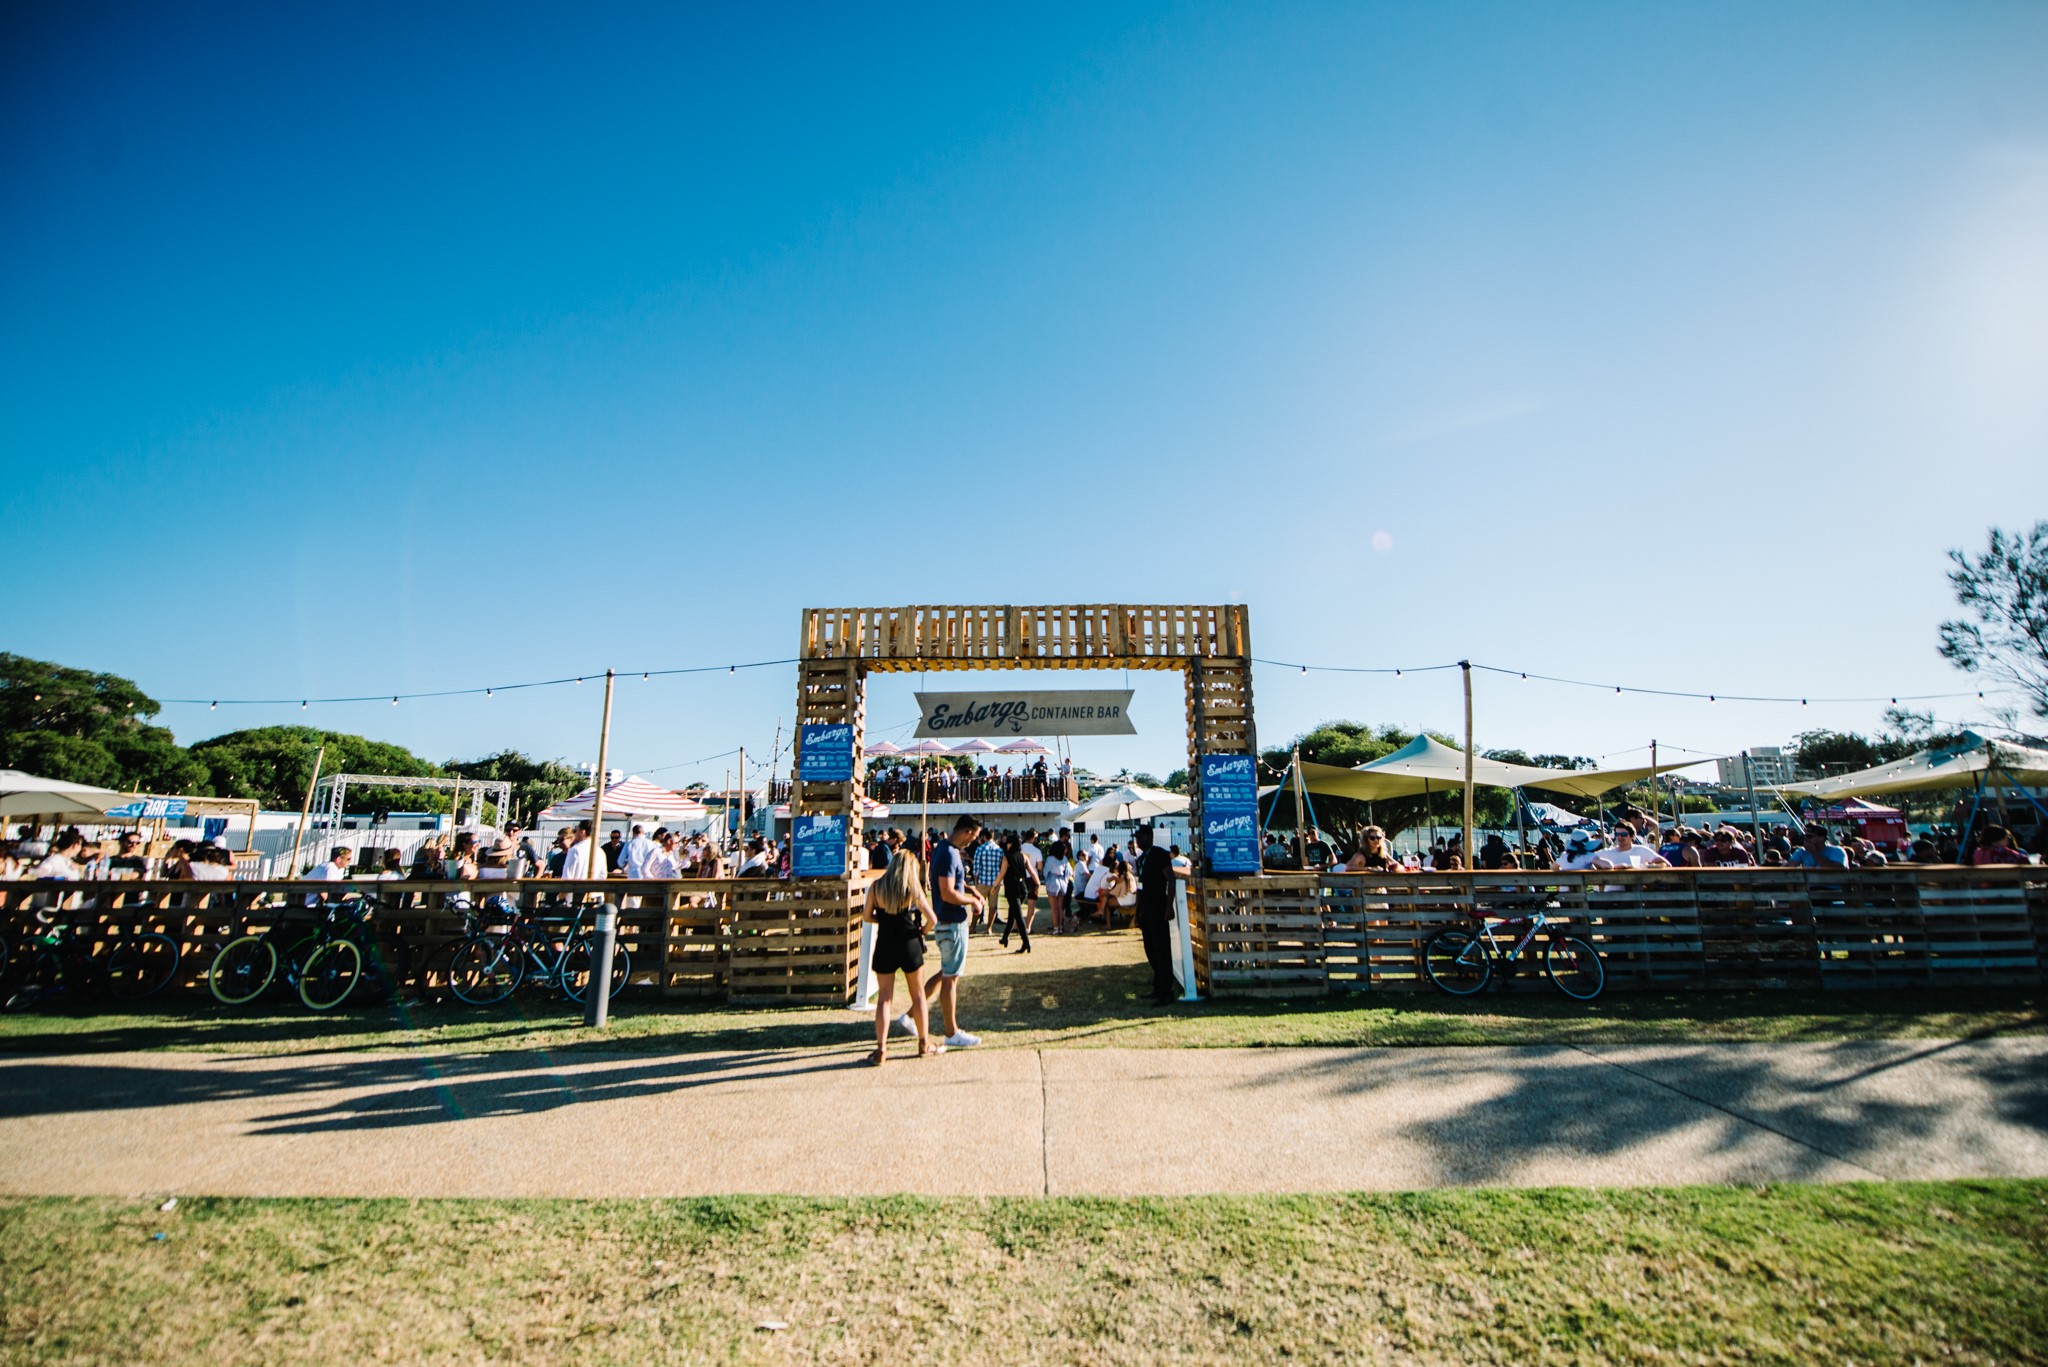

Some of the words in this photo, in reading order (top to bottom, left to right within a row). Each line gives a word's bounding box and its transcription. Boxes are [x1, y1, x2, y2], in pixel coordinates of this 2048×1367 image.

[928, 701, 1028, 731] Embargo
[1031, 706, 1093, 720] CONTAINER
[1097, 706, 1120, 718] BAR
[805, 728, 848, 745] Embargo
[1207, 759, 1249, 776] Embargo
[143, 799, 169, 816] BAR
[1208, 815, 1251, 834] Embargo
